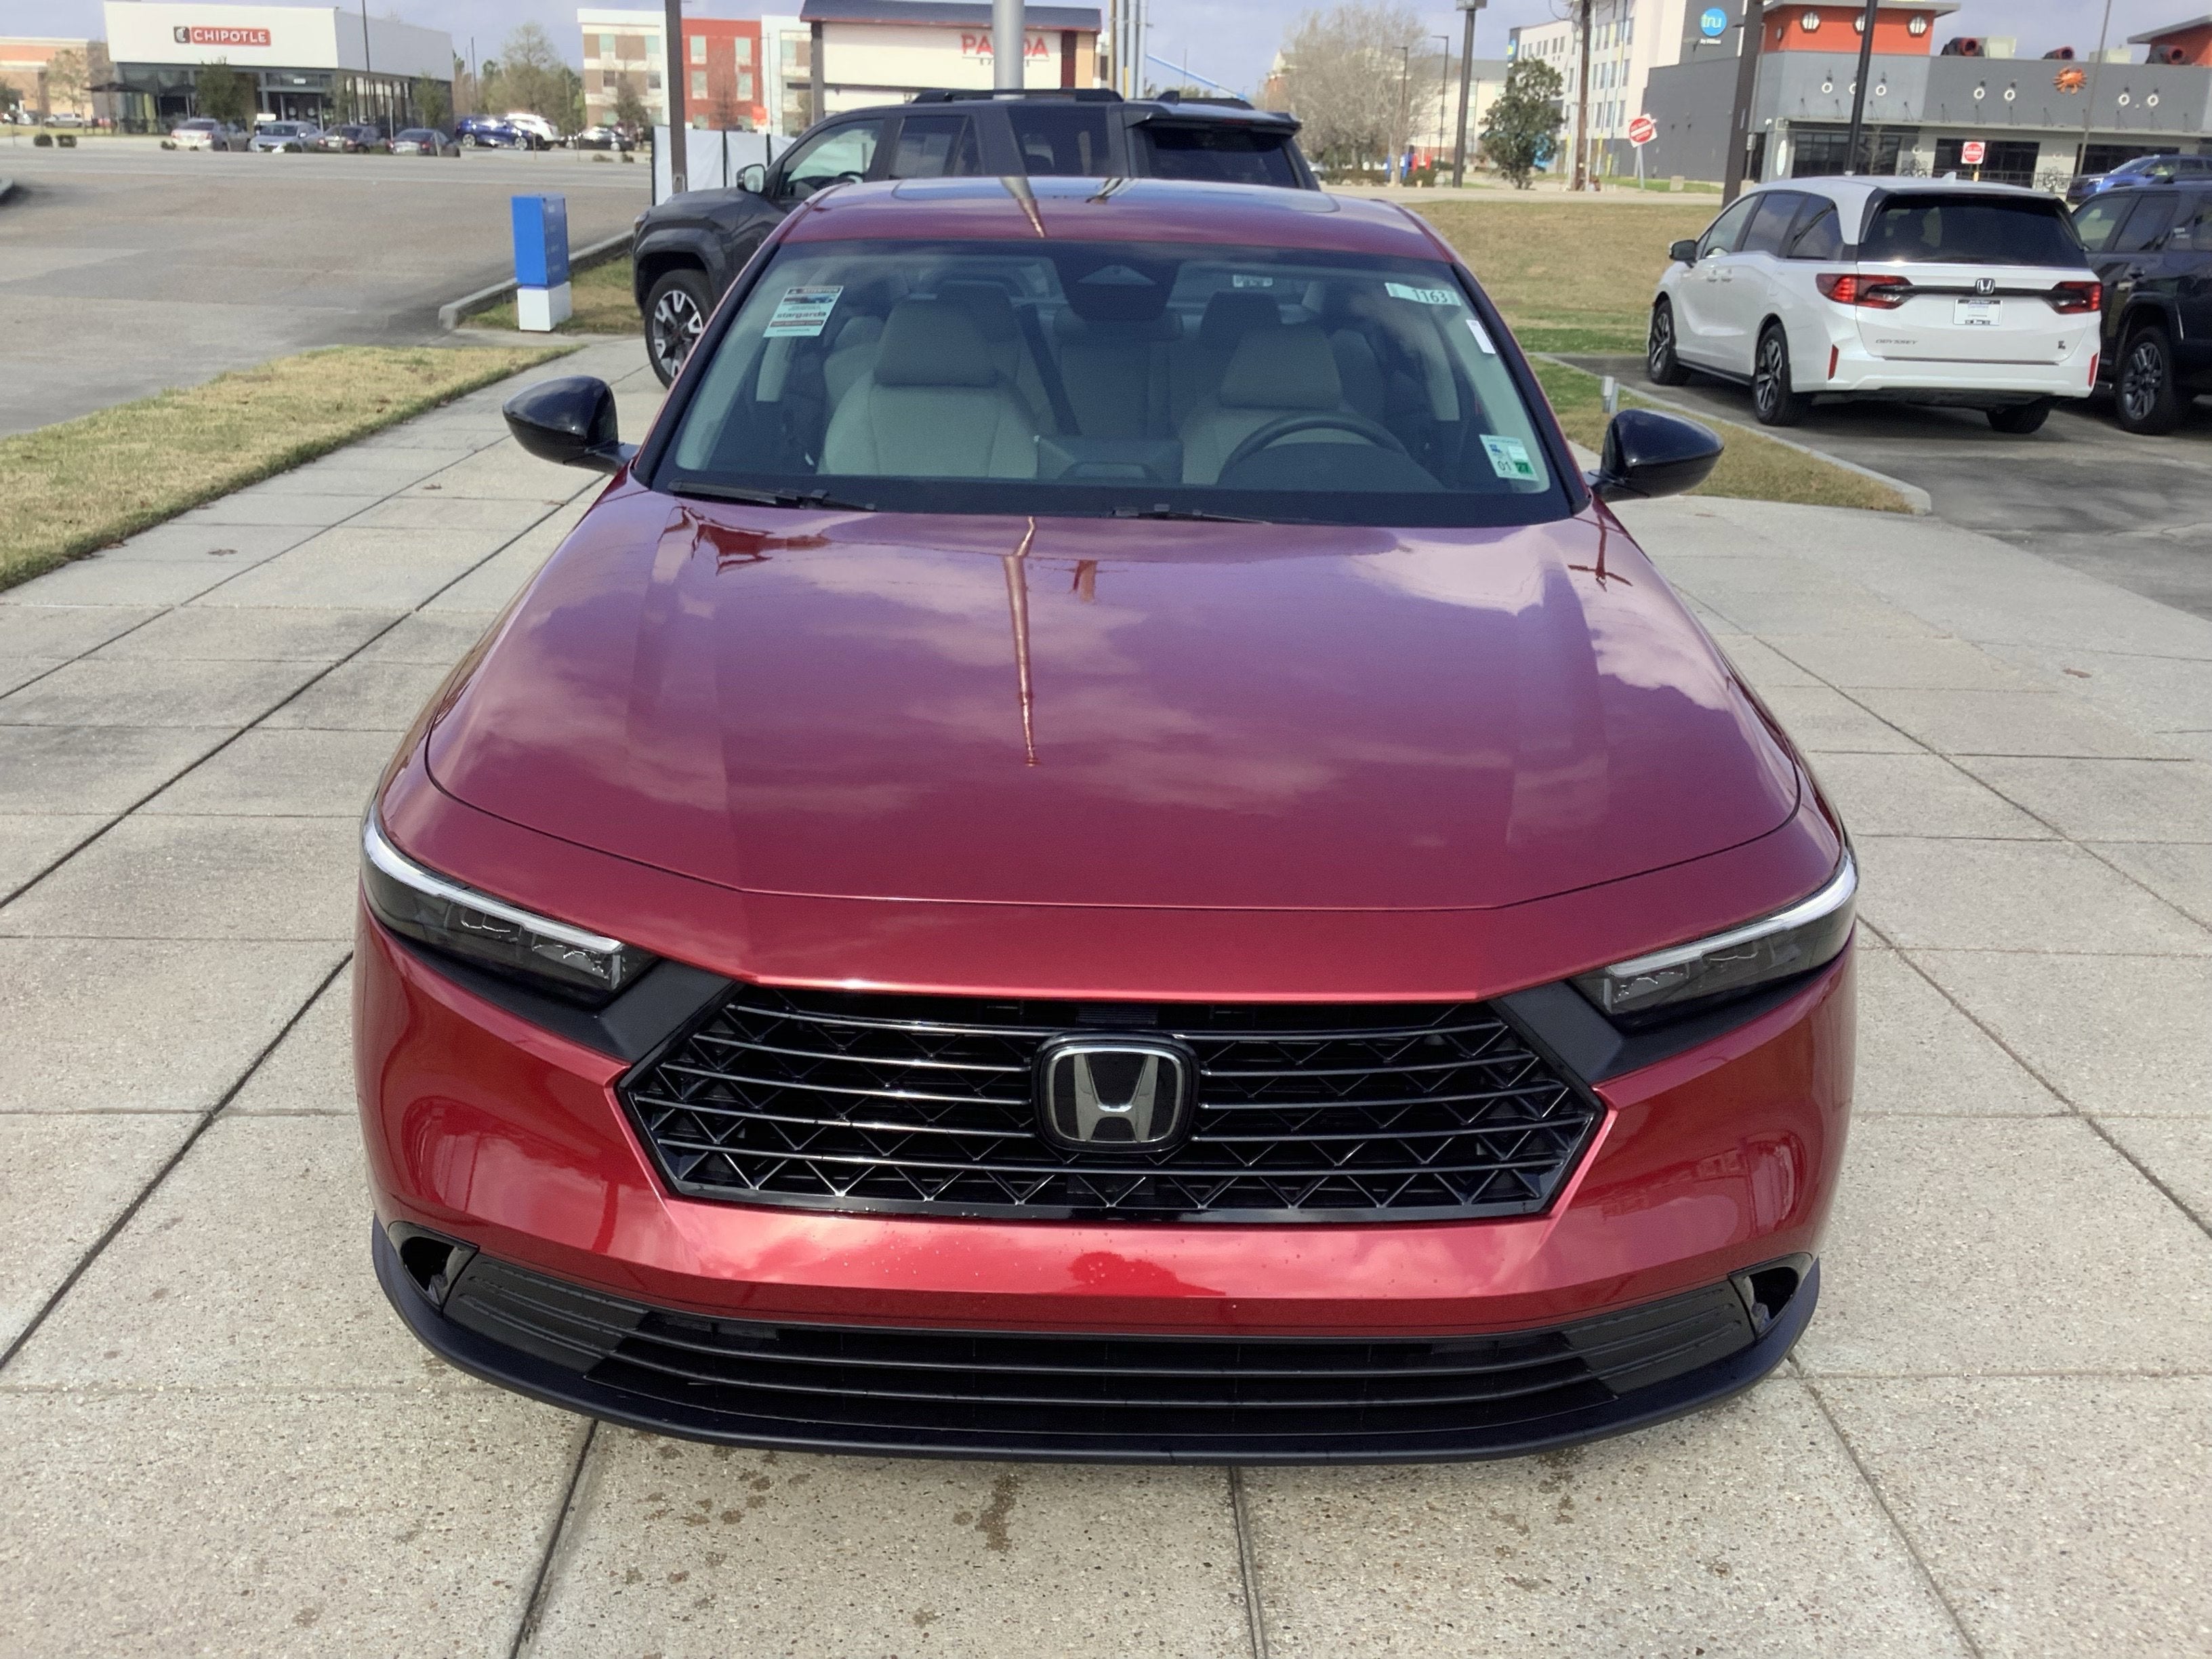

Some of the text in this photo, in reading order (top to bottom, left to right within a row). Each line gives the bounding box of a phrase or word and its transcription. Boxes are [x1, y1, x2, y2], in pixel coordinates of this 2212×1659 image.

[194, 29, 267, 43] CHIPOTLE
[961, 34, 1050, 58] PADA
[1412, 289, 1448, 303] 1163
